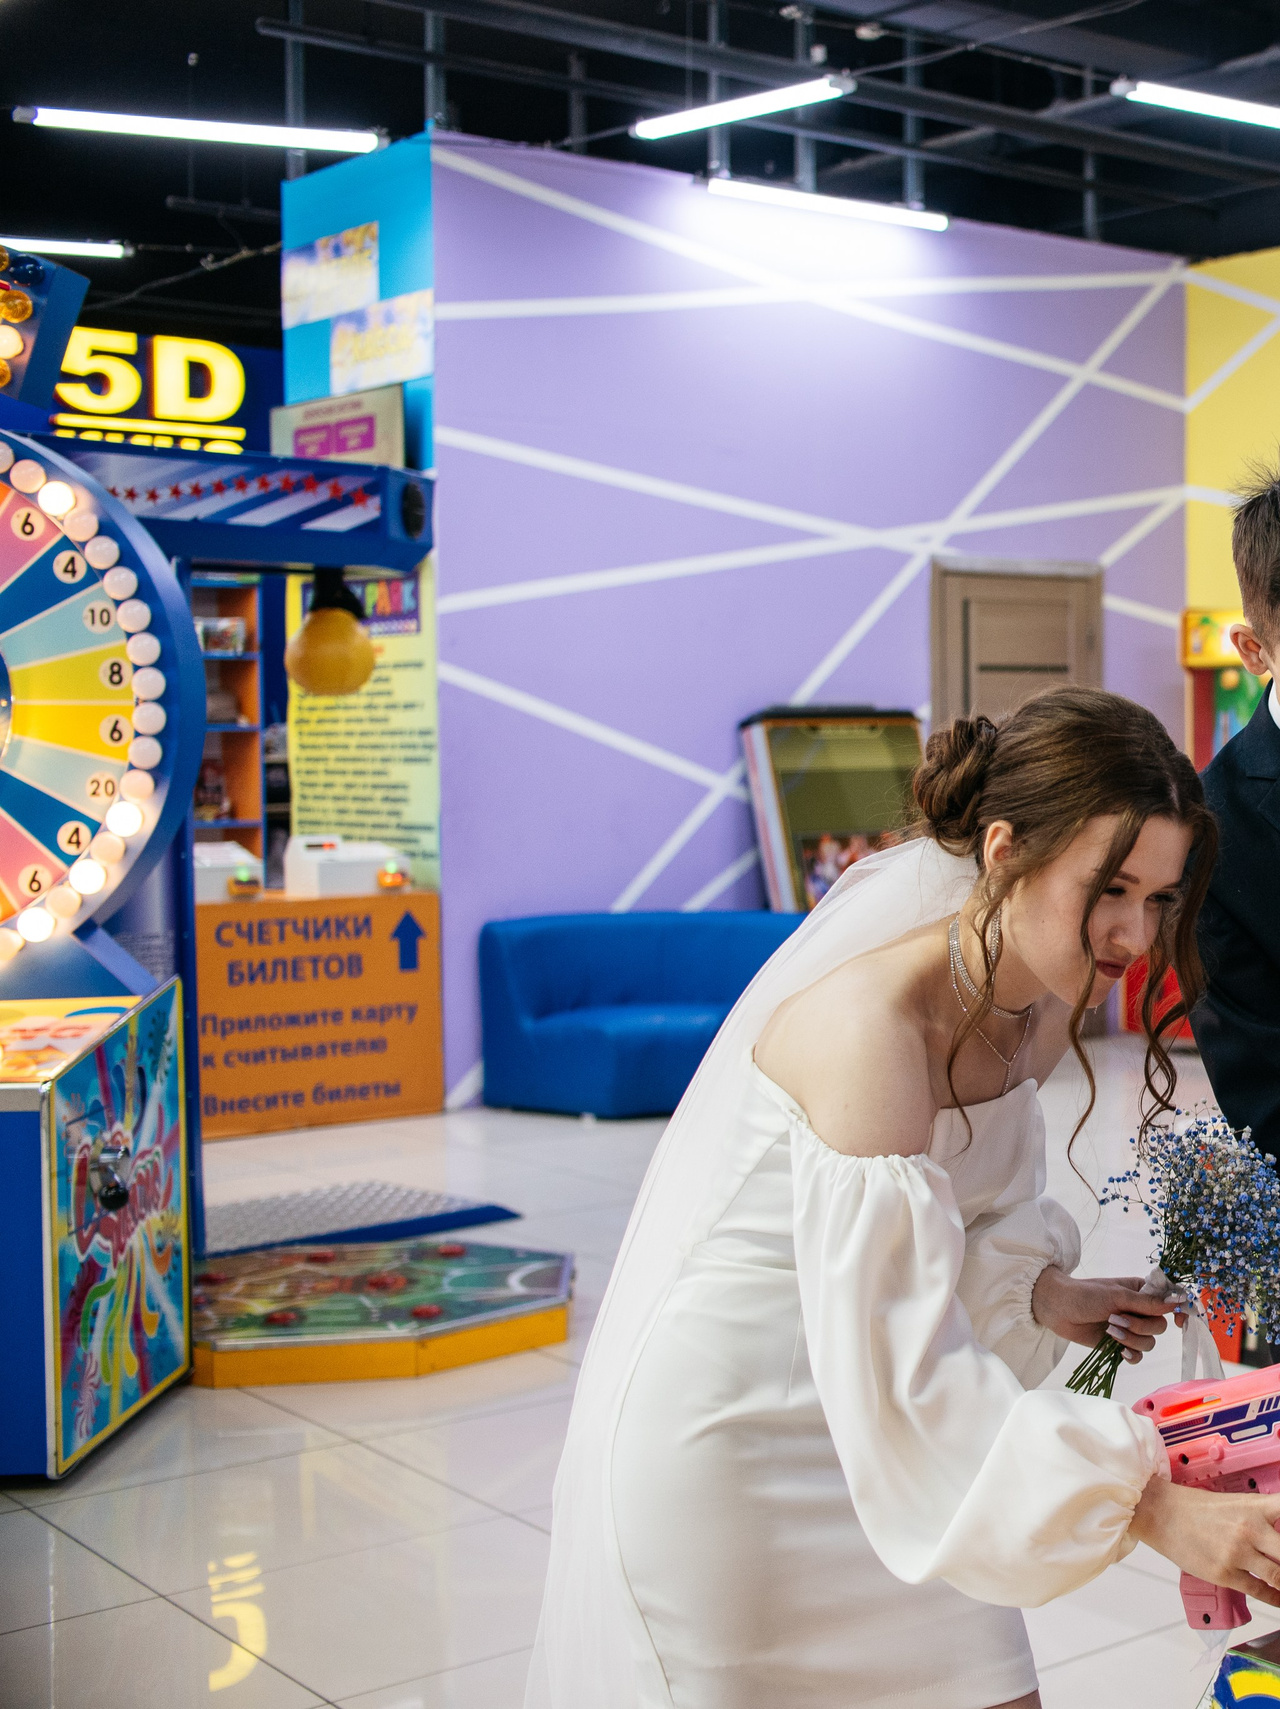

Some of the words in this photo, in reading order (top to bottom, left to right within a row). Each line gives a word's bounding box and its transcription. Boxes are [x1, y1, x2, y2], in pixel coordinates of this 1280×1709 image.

[56, 326, 246, 422] 5D
[20, 513, 35, 536] 6
[63, 557, 78, 577] 4
[87, 608, 112, 627] 10
[109, 662, 123, 685] 8
[109, 719, 123, 743] 6
[90, 778, 116, 798] 20
[68, 827, 82, 847] 4
[28, 870, 42, 893] 6
[214, 913, 373, 947] СЧЕТЧИКИ
[227, 953, 363, 987] БИЛЕТОВ
[201, 1006, 344, 1041] Приложите
[350, 1002, 419, 1026] карту
[202, 1052, 216, 1069] к
[223, 1036, 387, 1069] считывателю
[203, 1089, 305, 1118] Внесите
[312, 1079, 401, 1106] билеты
